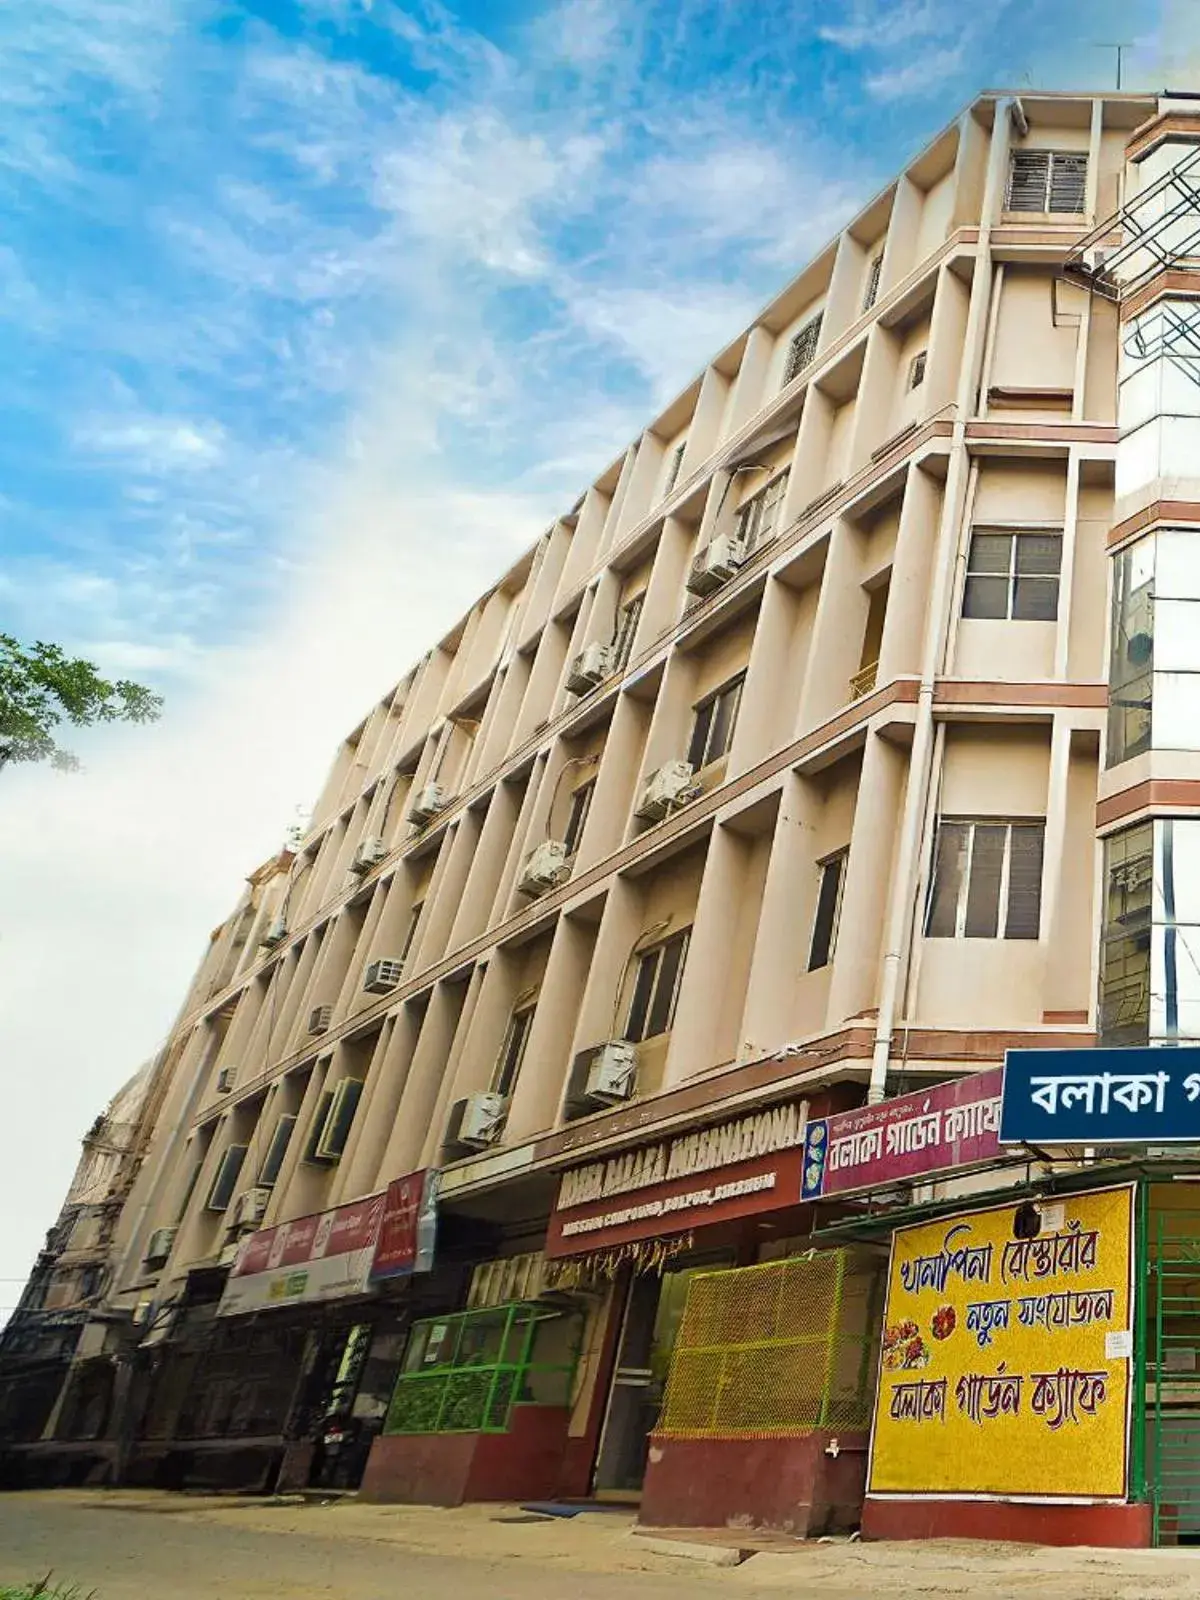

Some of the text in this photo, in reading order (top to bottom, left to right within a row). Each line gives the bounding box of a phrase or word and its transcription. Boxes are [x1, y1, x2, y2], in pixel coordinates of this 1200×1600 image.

[1031, 1070, 1168, 1114] বলাকা
[829, 1127, 884, 1171] বলাকা
[886, 1098, 943, 1156] গার্ডেন
[901, 1224, 993, 1294] খানাপিনা
[966, 1289, 1114, 1348] নতুন সংযোজন
[890, 1361, 1107, 1430] বলাকা গার্ডেন ক্যাফে
